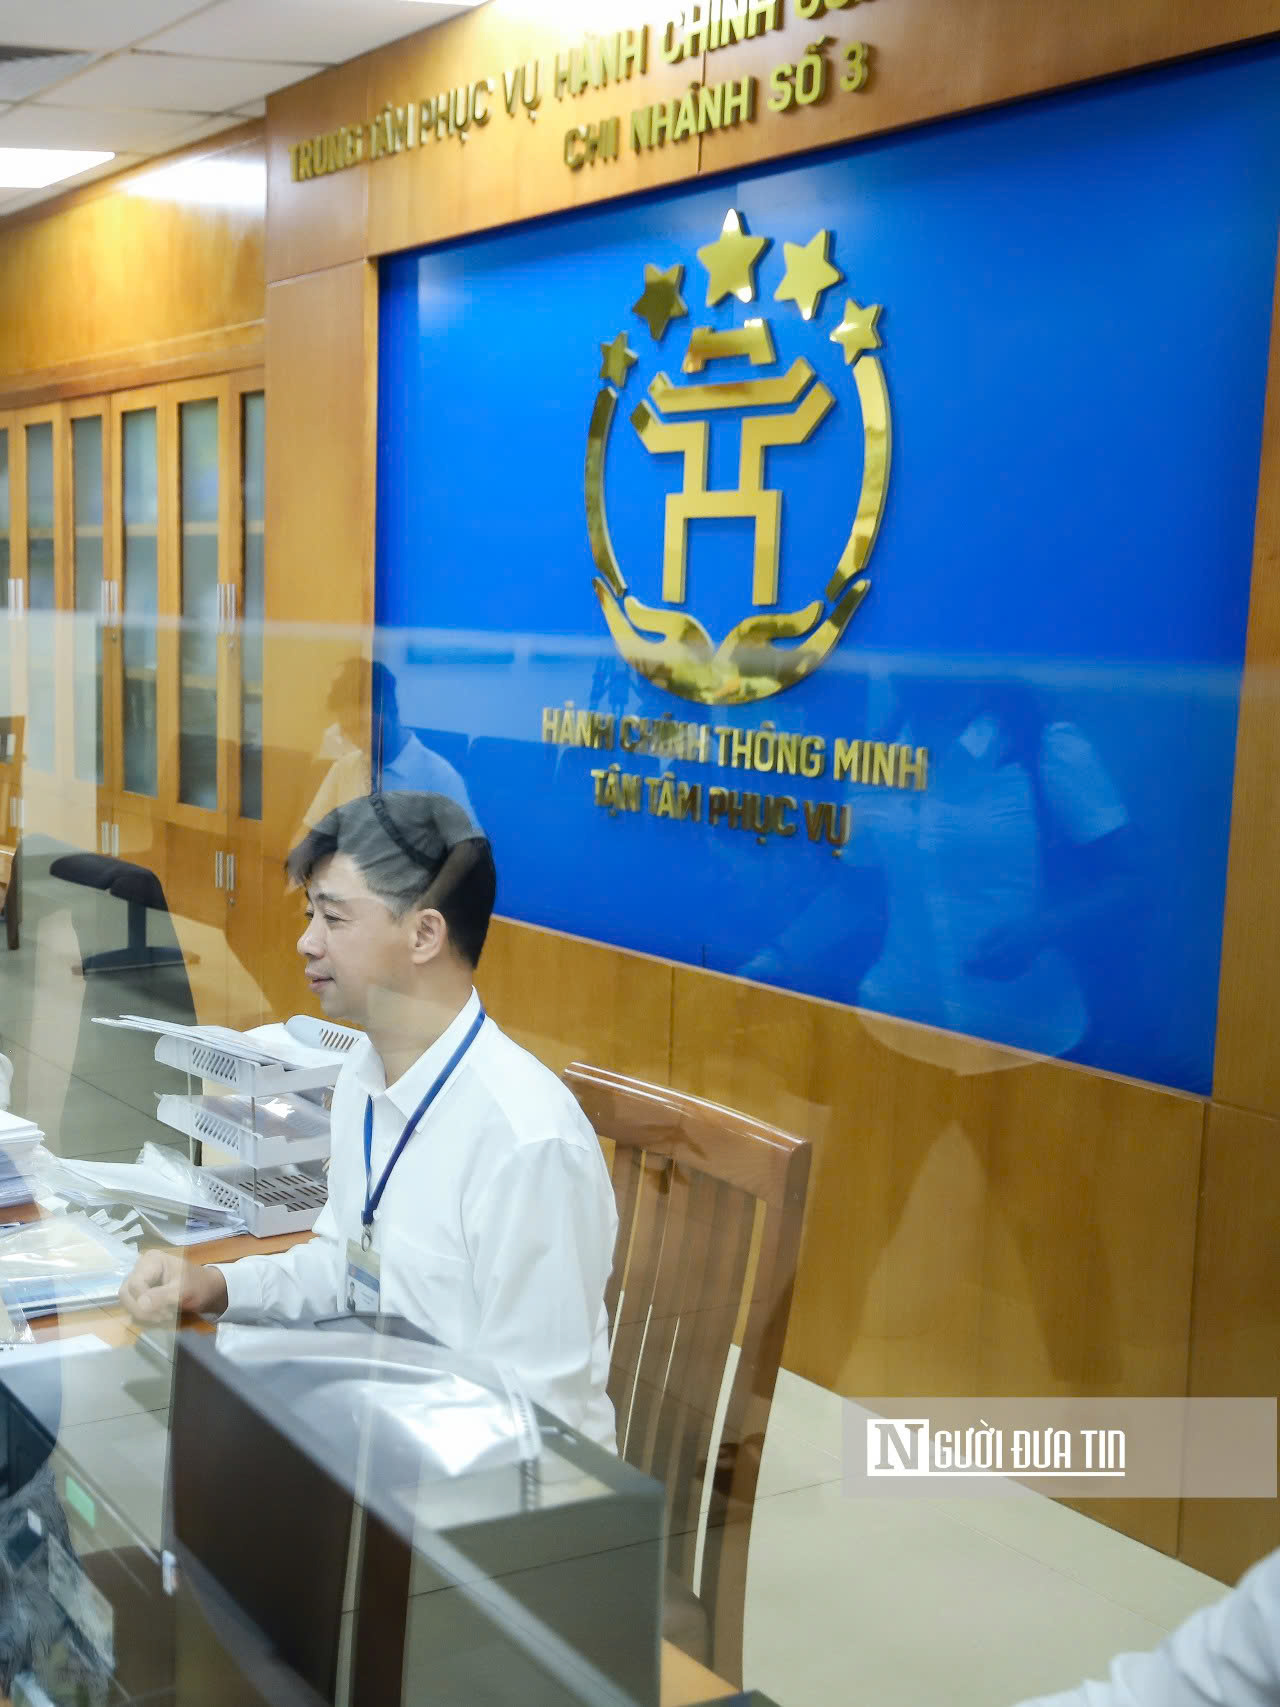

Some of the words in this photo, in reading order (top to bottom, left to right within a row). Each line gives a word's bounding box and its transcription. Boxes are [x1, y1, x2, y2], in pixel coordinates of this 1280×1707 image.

[420, 77, 495, 144] PHỤC
[564, 116, 620, 168] CHI
[630, 74, 754, 150] NHÁNH
[767, 35, 827, 112] SỐ
[839, 41, 870, 92] 3
[714, 720, 825, 778] THÔNG
[832, 737, 929, 791] MINH
[590, 762, 642, 816] TẬN
[644, 772, 702, 822] TÂM
[709, 786, 798, 845] PHỤC
[804, 800, 852, 858] VỤ
